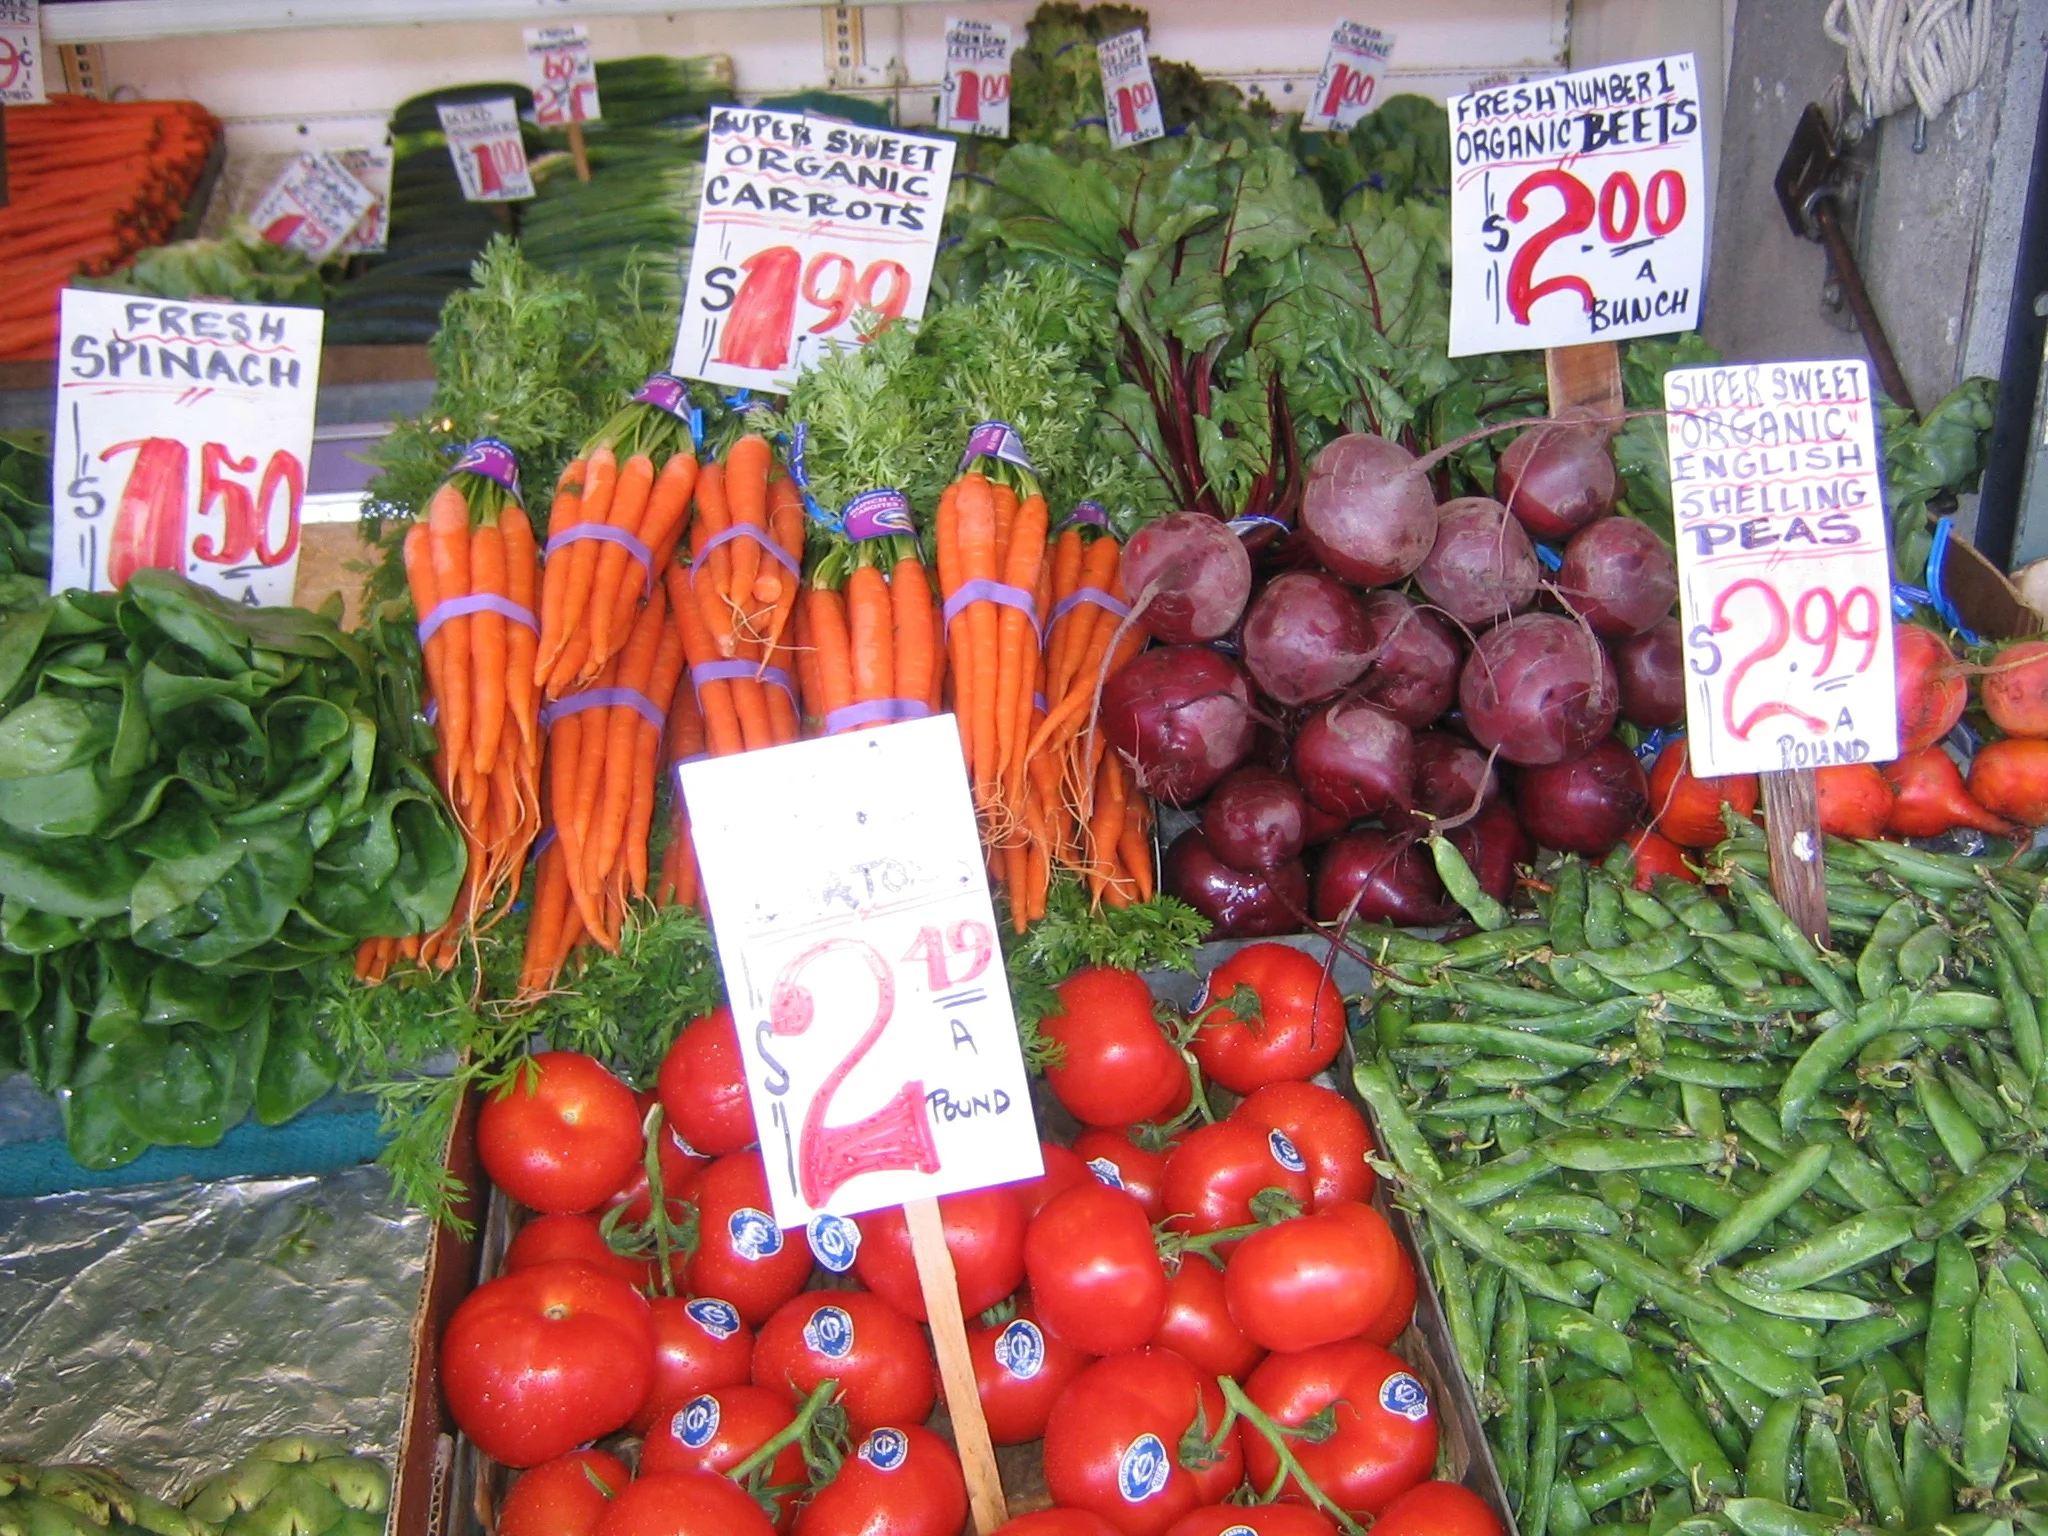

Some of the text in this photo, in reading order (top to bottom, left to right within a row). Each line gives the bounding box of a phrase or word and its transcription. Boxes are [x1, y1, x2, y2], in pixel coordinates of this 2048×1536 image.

[1457, 81, 1556, 124] FRESH
[711, 110, 942, 171] SUPER SWEET
[1456, 98, 1697, 165] ORGANIC BEETS
[725, 144, 930, 197] ORGANIC
[706, 175, 926, 231] CARROTS
[1636, 258, 1657, 283] A
[125, 302, 285, 344] FRESH
[1588, 288, 1689, 333] BUNCH
[71, 334, 301, 388] SPINACH
[1670, 366, 1860, 411] SUPER SWEET
[1671, 443, 1863, 483] ENGLISH
[1679, 479, 1867, 519] SHELLING
[1682, 513, 1862, 556] PEAS
[1833, 705, 1855, 733] A
[1776, 733, 1871, 769] POUND
[949, 1018, 979, 1055] A
[925, 1087, 1011, 1125] POUND
